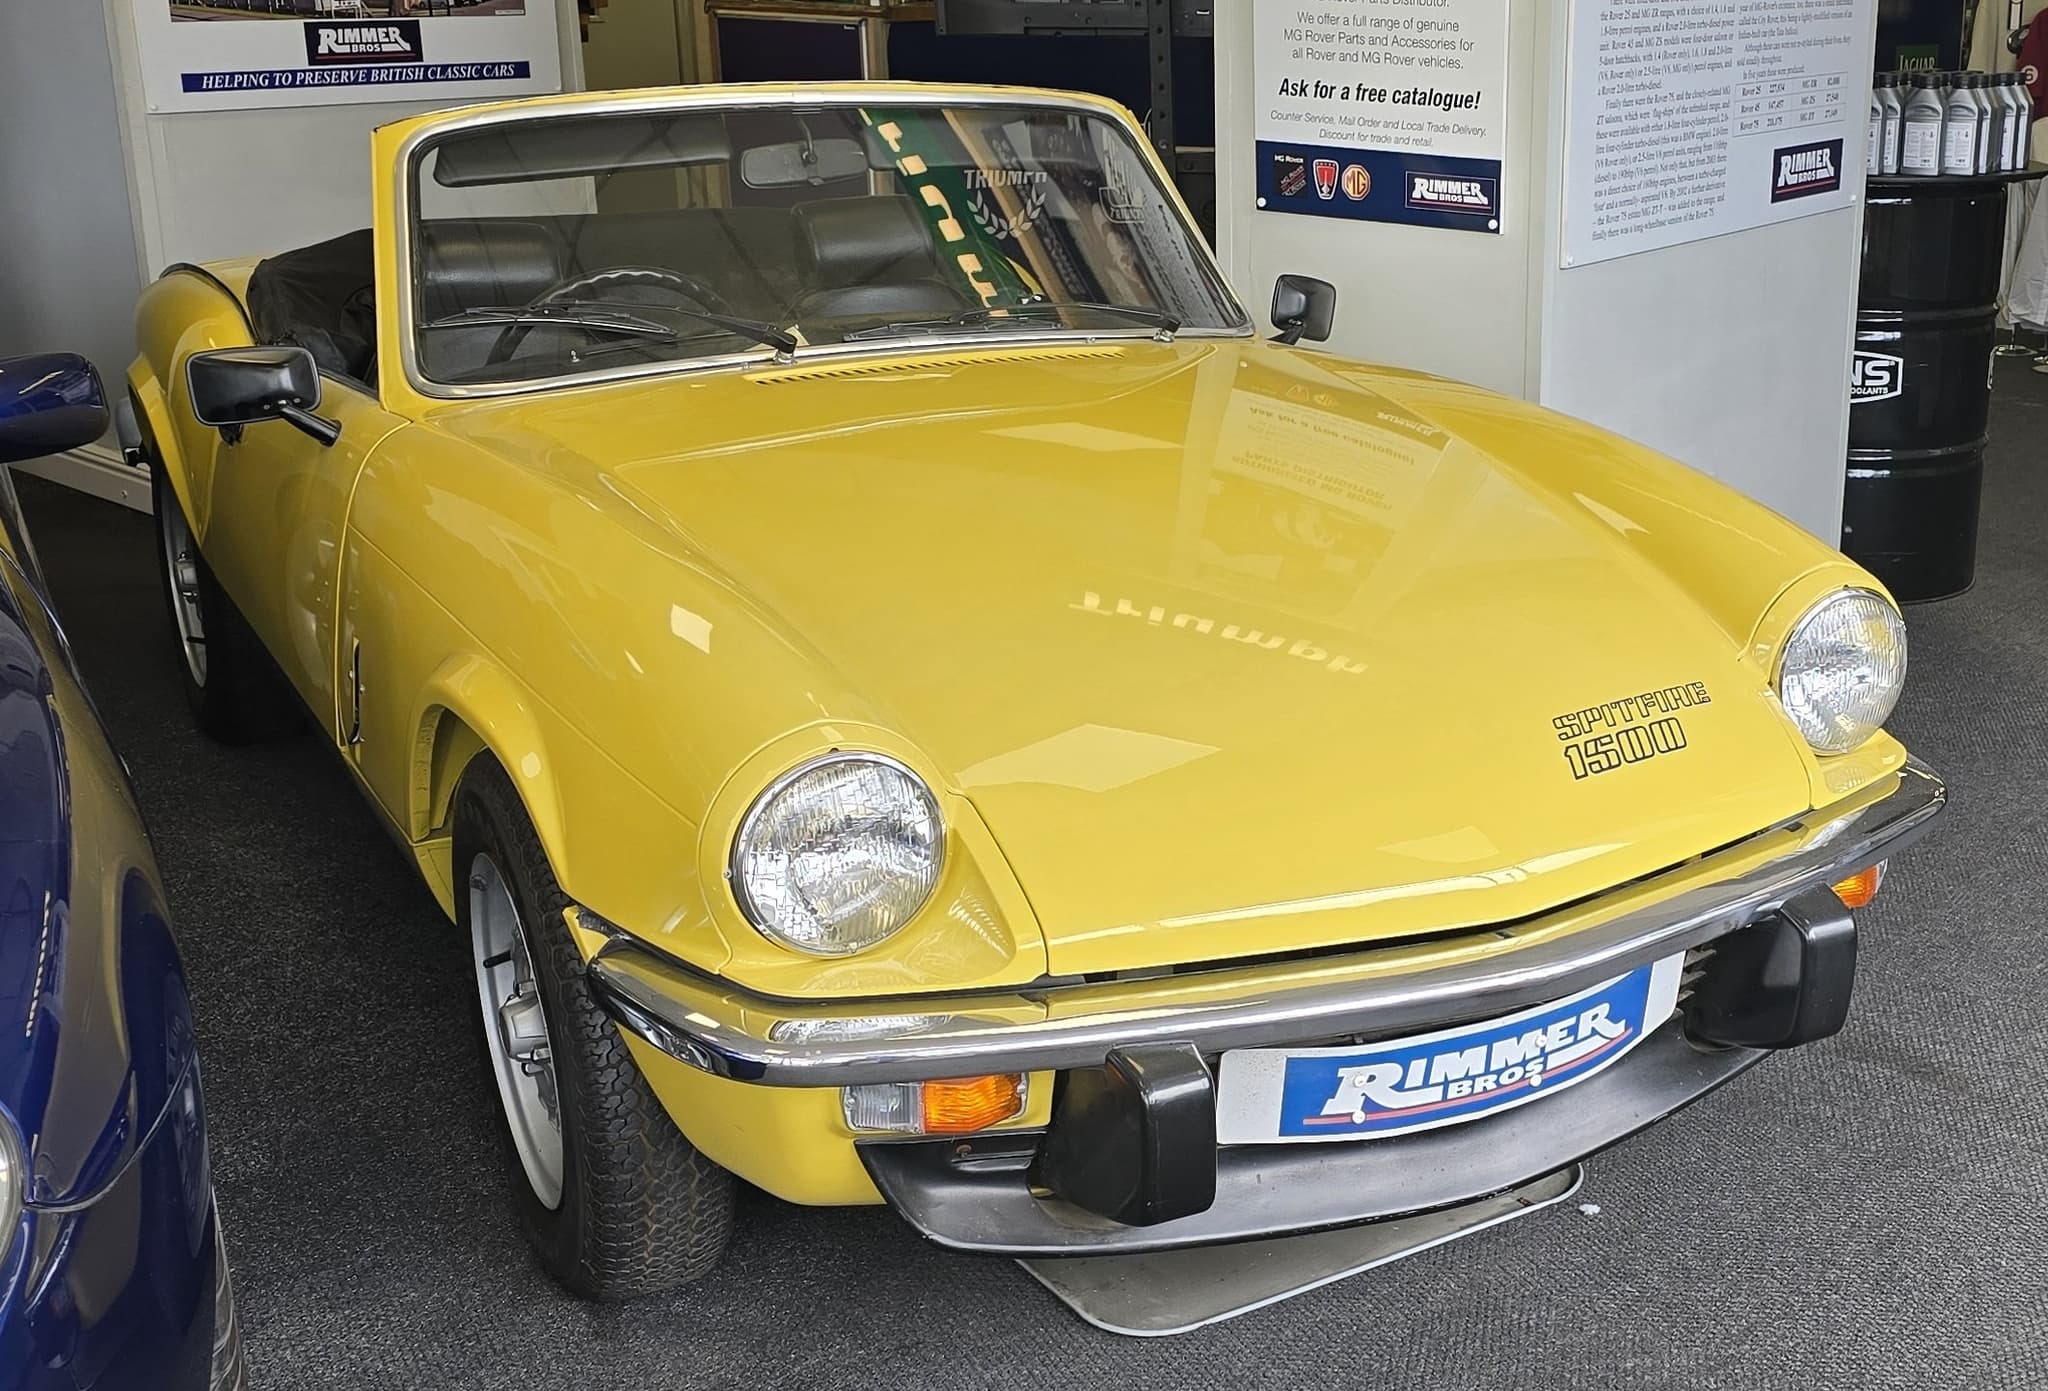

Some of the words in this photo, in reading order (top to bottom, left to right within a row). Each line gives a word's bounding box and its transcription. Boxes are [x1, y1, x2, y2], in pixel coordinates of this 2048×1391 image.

[1297, 12, 1314, 24] We
[1317, 13, 1340, 25] offer
[1343, 16, 1349, 26] a
[1352, 14, 1366, 27] full
[1370, 16, 1400, 31] range
[1403, 17, 1414, 30] of
[1416, 20, 1459, 33] genuine
[1609, 10, 1623, 19] Rover
[1640, 8, 1650, 18] MG
[1665, 22, 1678, 31] Rover
[318, 27, 411, 53] RIMMER
[352, 44, 380, 53] BROS
[1284, 28, 1302, 41] MG
[1305, 30, 1335, 43] Rover
[1338, 32, 1365, 45] Parts
[1368, 34, 1388, 46] and
[1392, 35, 1456, 50] Accessories
[1460, 38, 1474, 51] for
[1612, 39, 1625, 49] Rover
[1644, 37, 1654, 47] MG
[1292, 48, 1303, 58] all
[1306, 48, 1336, 61] Rover
[1339, 51, 1358, 62] and
[1362, 52, 1380, 63] MG
[1384, 52, 1415, 66] Rover
[1418, 55, 1464, 69] vehicles.
[1900, 55, 1936, 71] JAGUAR
[202, 73, 270, 89] HELPING
[274, 72, 292, 86] TO
[295, 69, 368, 85] PRESERVE
[371, 67, 424, 82] BRITISH
[427, 65, 480, 80] CLASSIC
[482, 64, 514, 78] CARS
[1279, 78, 1309, 97] Ask
[1314, 80, 1336, 98] for
[1340, 86, 1350, 100] a
[1356, 83, 1387, 102] free
[1392, 87, 1480, 111] catalogue!
[1601, 84, 1615, 94] Rover
[1654, 94, 1667, 103] Rover
[1271, 110, 1303, 121] Counter
[1304, 112, 1335, 124] Service,
[1338, 116, 1355, 125] Mail
[1357, 117, 1381, 127] Order
[1383, 120, 1399, 129] and
[1401, 120, 1424, 131] Local
[1427, 122, 1450, 133] Trade
[1452, 124, 1486, 137] Delivery.
[1319, 129, 1354, 140] Discount
[1358, 132, 1368, 141] for
[1370, 134, 1392, 143] trade
[1394, 136, 1410, 145] and
[1777, 148, 1834, 187] RIMMER
[1799, 170, 1816, 183] BROS
[1346, 169, 1366, 194] MG
[1412, 178, 1488, 205] RIMMER
[1440, 194, 1462, 202] BROS
[1695, 209, 1708, 219] Rover
[1552, 680, 1711, 742] SPITFIRE
[1564, 717, 1687, 780] 1500
[1320, 1002, 1627, 1116] RIMMER
[1447, 1062, 1546, 1100] BROS
